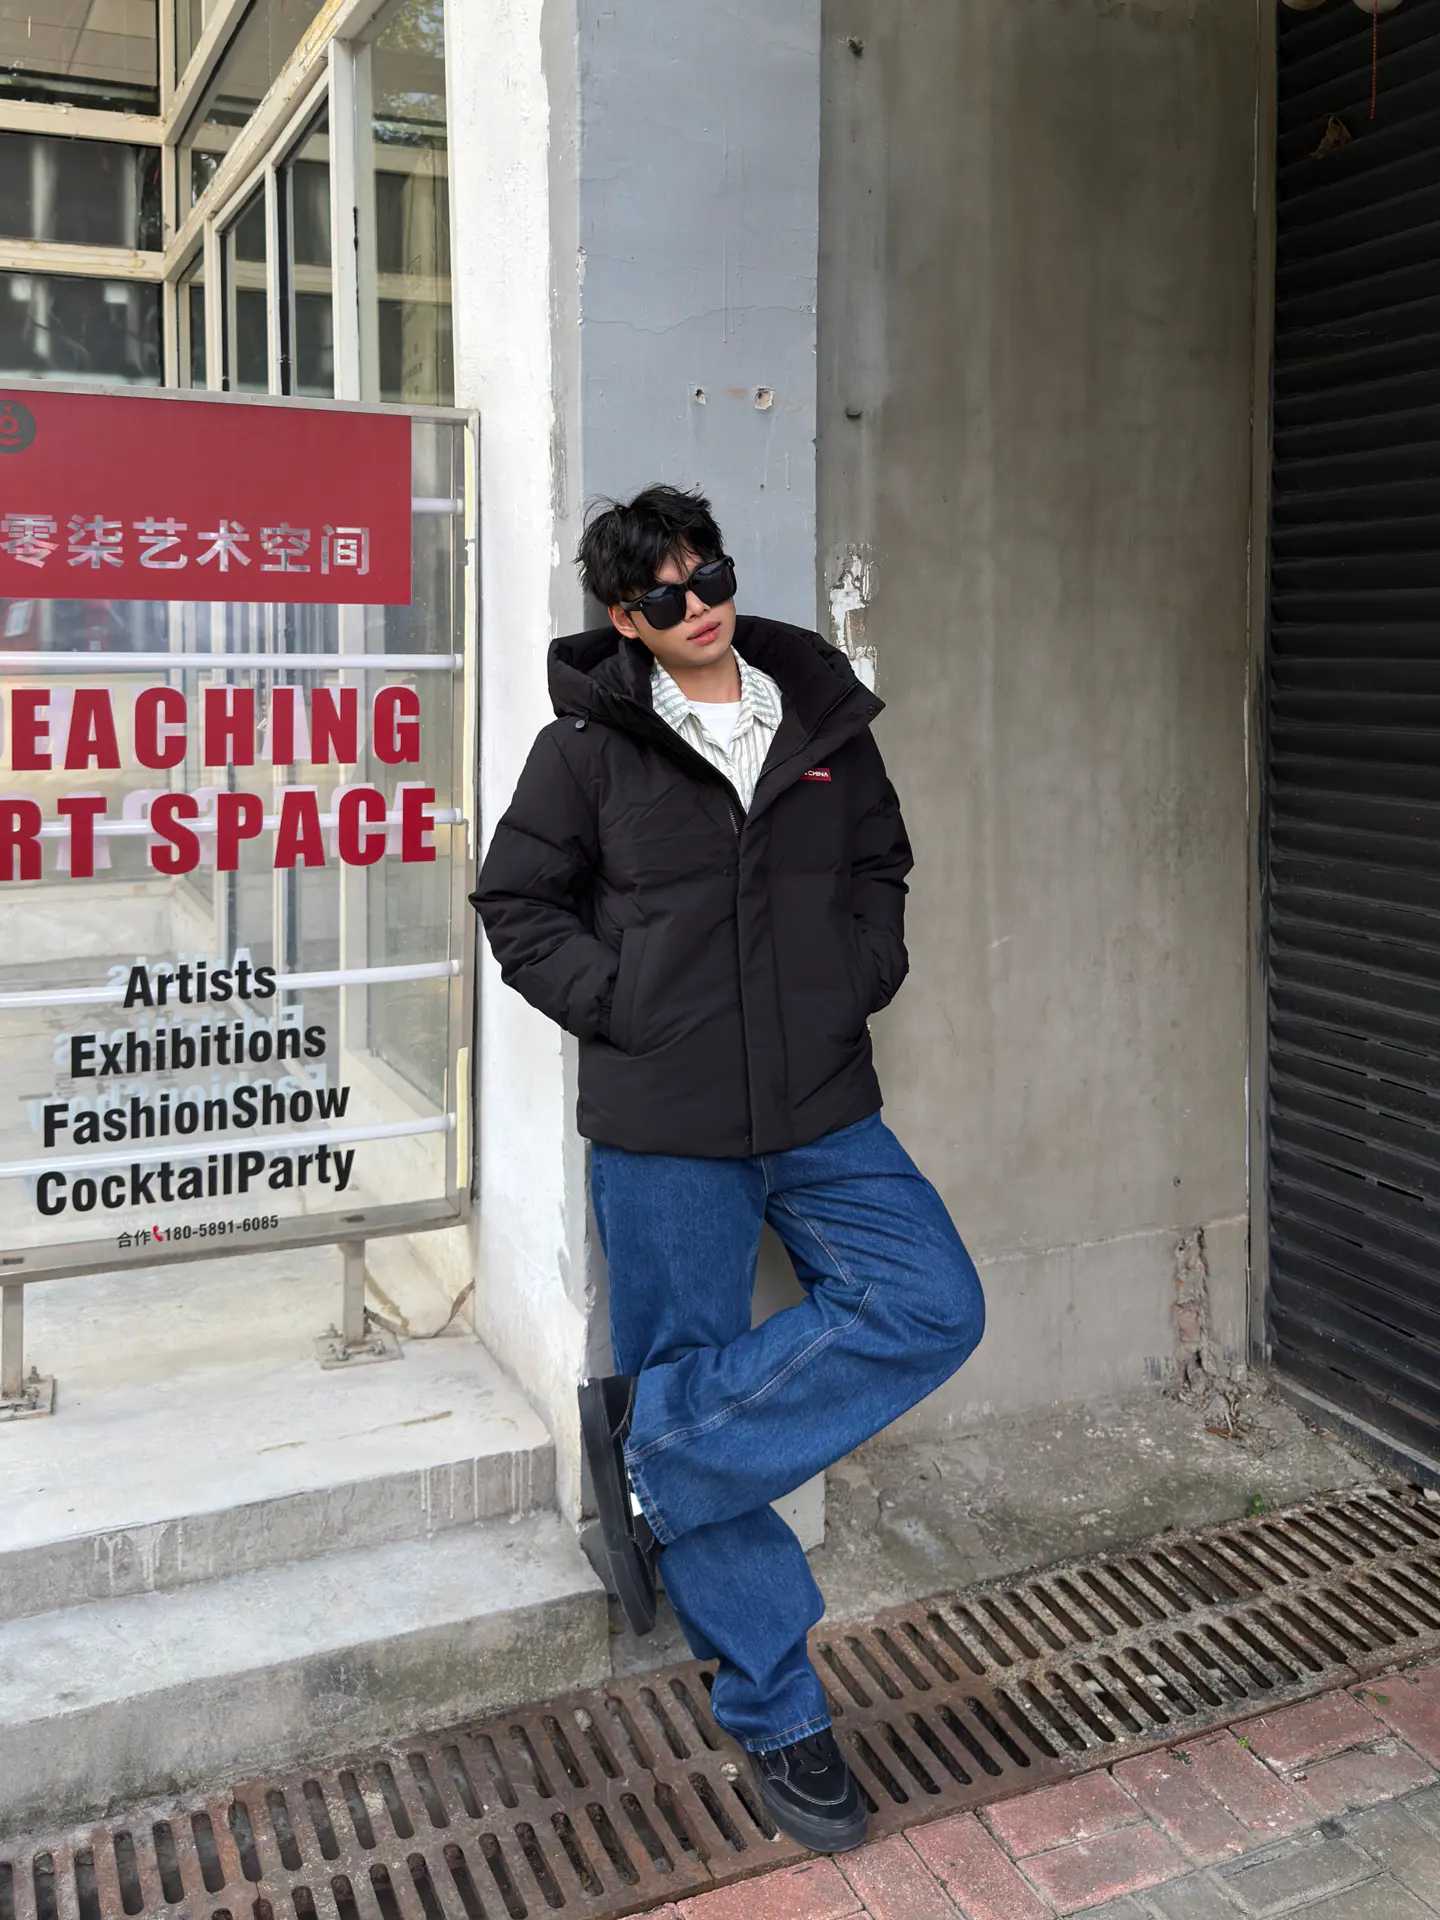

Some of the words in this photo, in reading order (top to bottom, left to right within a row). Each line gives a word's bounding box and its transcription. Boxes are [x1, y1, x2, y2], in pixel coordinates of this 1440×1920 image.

[0, 513, 370, 575] 零柒艺术空间
[12, 687, 421, 770] EACHING
[150, 787, 436, 875] SPACE
[123, 961, 277, 1008] Artists
[71, 1023, 326, 1078] Exhibitions
[43, 1086, 350, 1147] FashionShow
[36, 1144, 355, 1215] CocktailParty
[117, 1231, 151, 1248] 合作
[164, 1215, 279, 1241] 180-5891-6085
